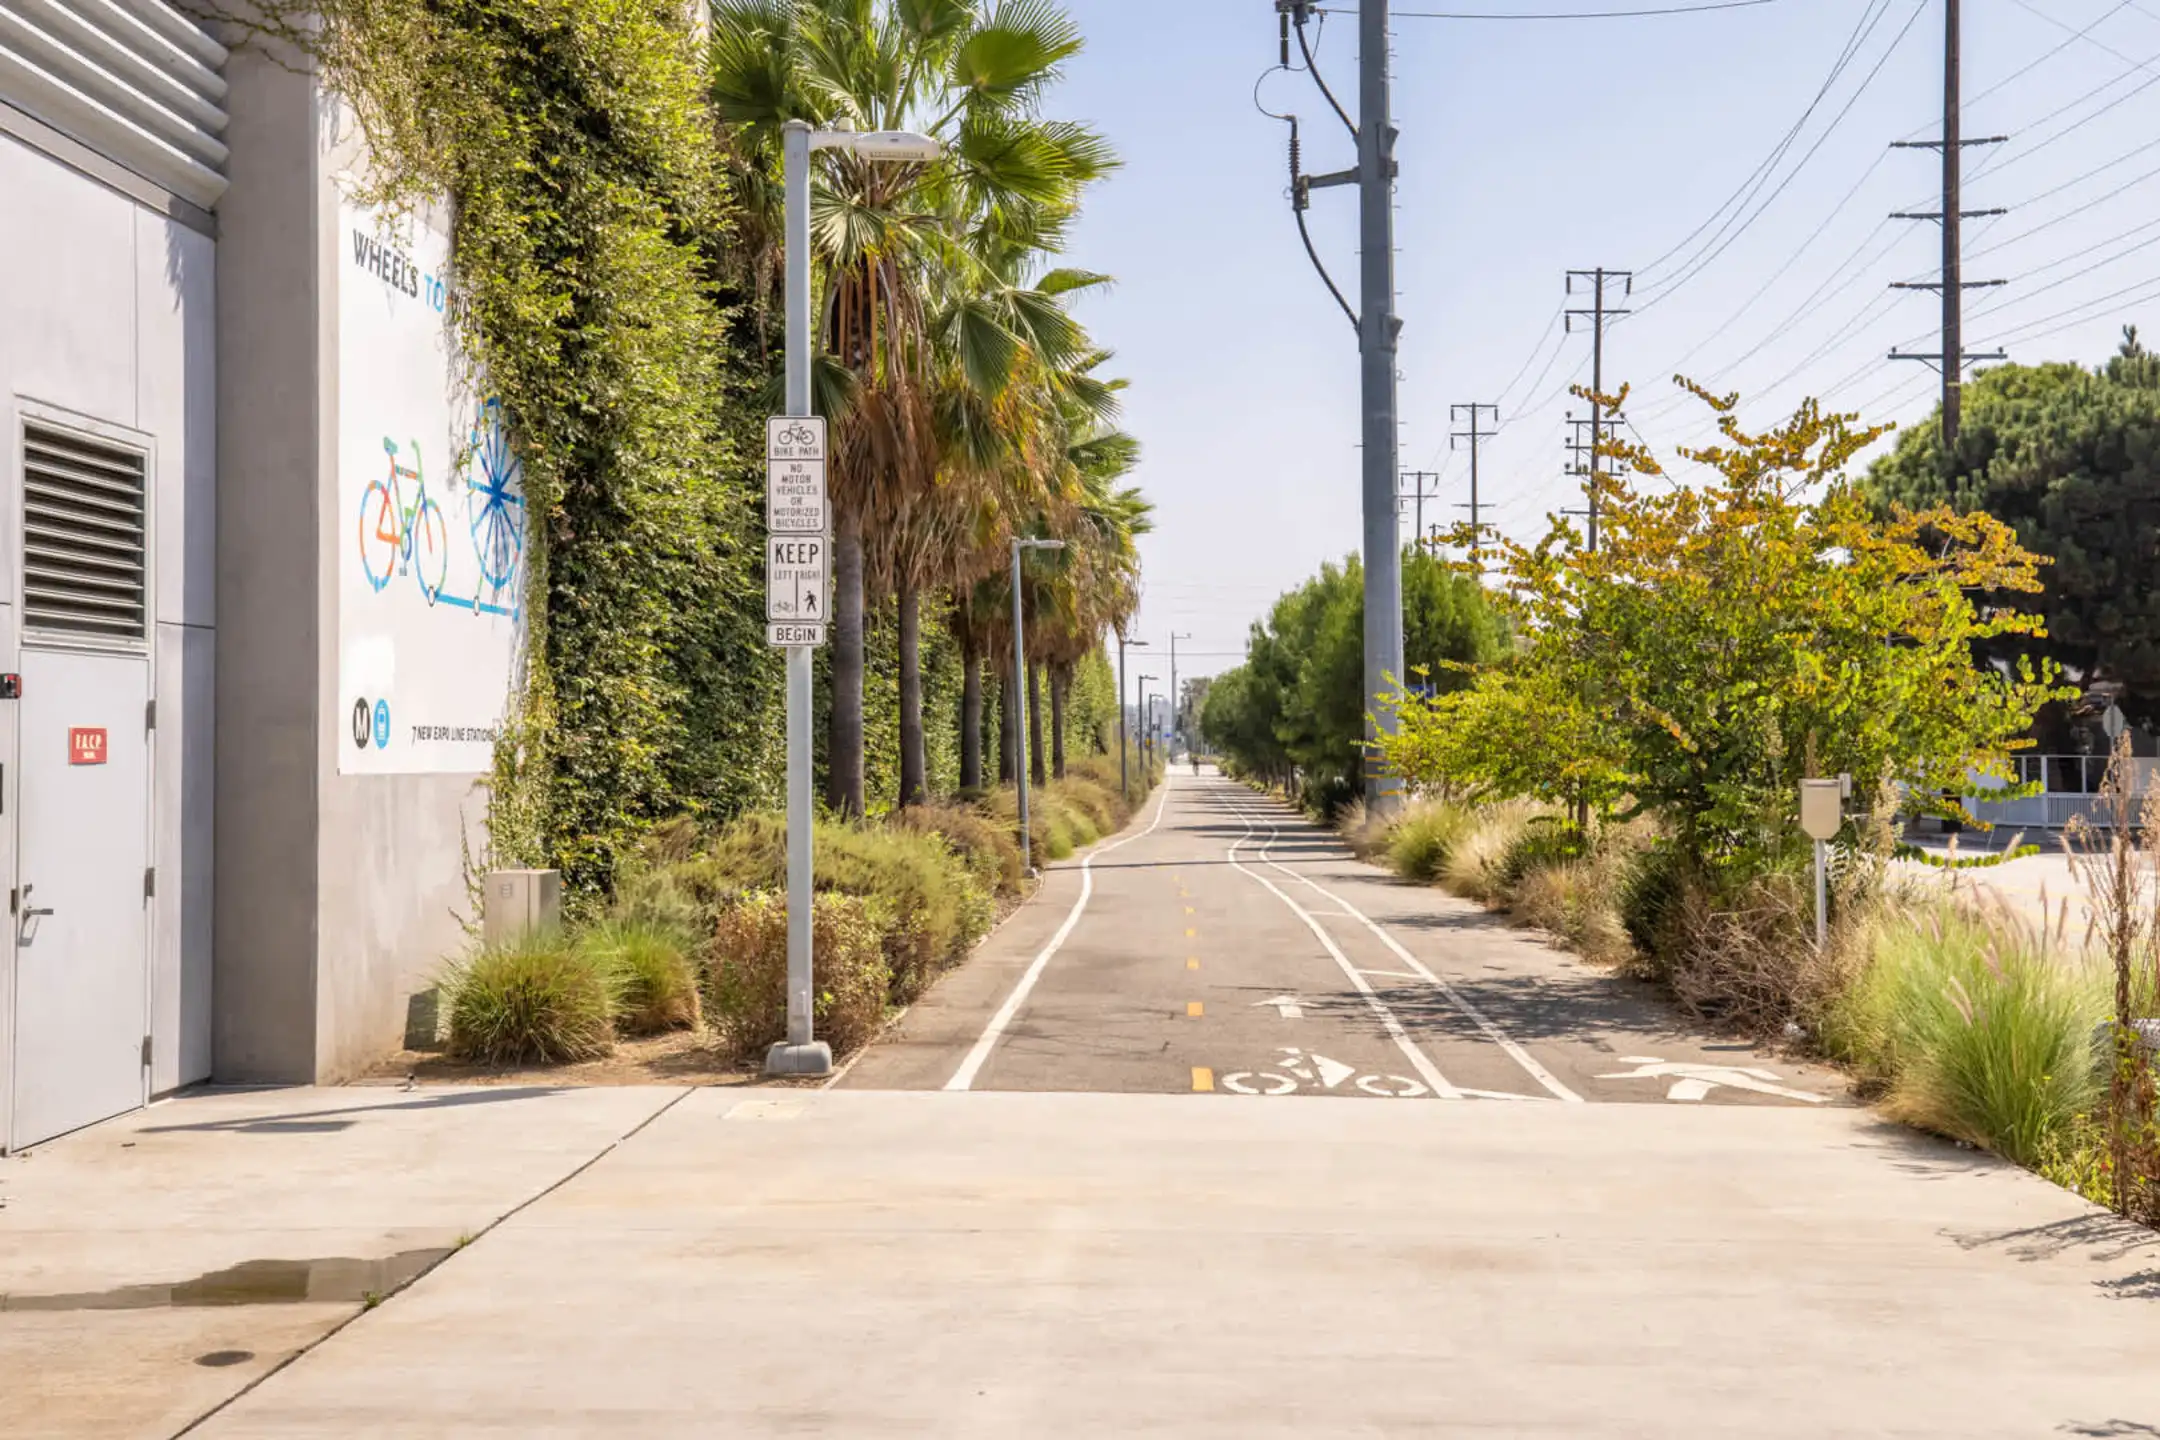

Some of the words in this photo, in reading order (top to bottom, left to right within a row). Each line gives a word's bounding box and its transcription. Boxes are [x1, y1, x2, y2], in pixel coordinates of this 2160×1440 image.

[353, 227, 419, 298] WHEELS
[774, 447, 793, 457] BIKE
[800, 447, 820, 457] PATH
[790, 464, 803, 473] NO
[781, 475, 811, 483] MOTOR
[776, 485, 818, 495] VEHICLES
[790, 497, 803, 506] OR
[774, 508, 820, 517] MOTORIZED
[775, 518, 819, 528] BICYCLES
[775, 543, 819, 564] KEEP
[774, 570, 793, 580] LEFT
[776, 627, 816, 641] BEGIN
[417, 726, 433, 741] NEW
